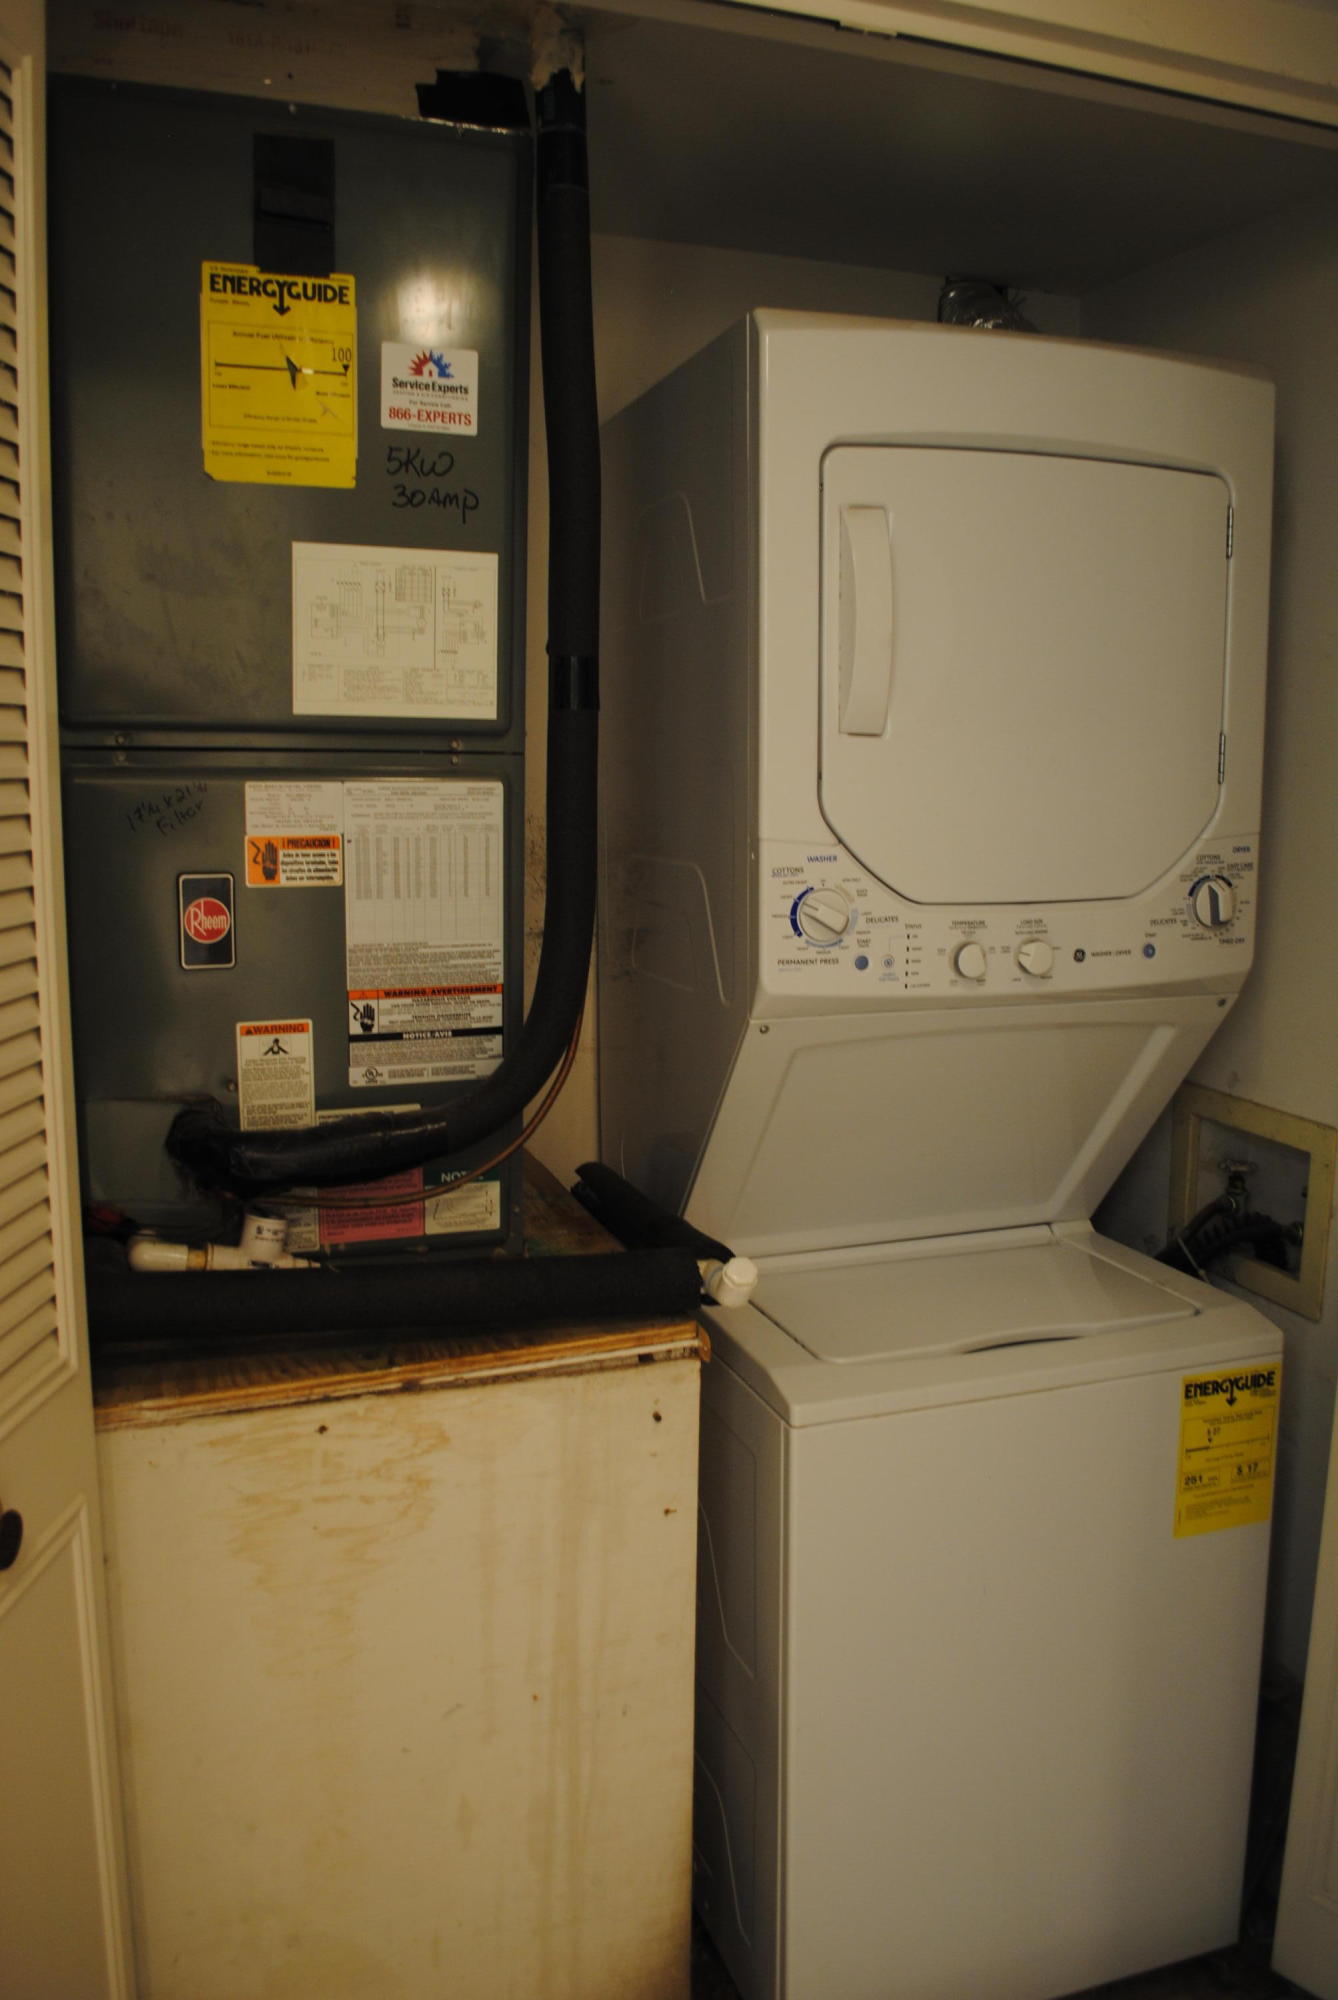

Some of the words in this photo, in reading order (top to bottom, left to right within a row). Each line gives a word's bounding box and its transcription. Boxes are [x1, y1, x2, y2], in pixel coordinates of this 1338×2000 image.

[210, 272, 351, 306] ENERGYGUIDE
[332, 347, 352, 363] 100
[392, 377, 430, 391] Service
[431, 379, 469, 395] Experts
[388, 406, 472, 426] 866-EXPERTS
[807, 855, 838, 863] WASHER
[189, 898, 228, 937] Rheem
[253, 1024, 304, 1035] WARNING
[1184, 1371, 1275, 1400] ENERGYGUIDE
